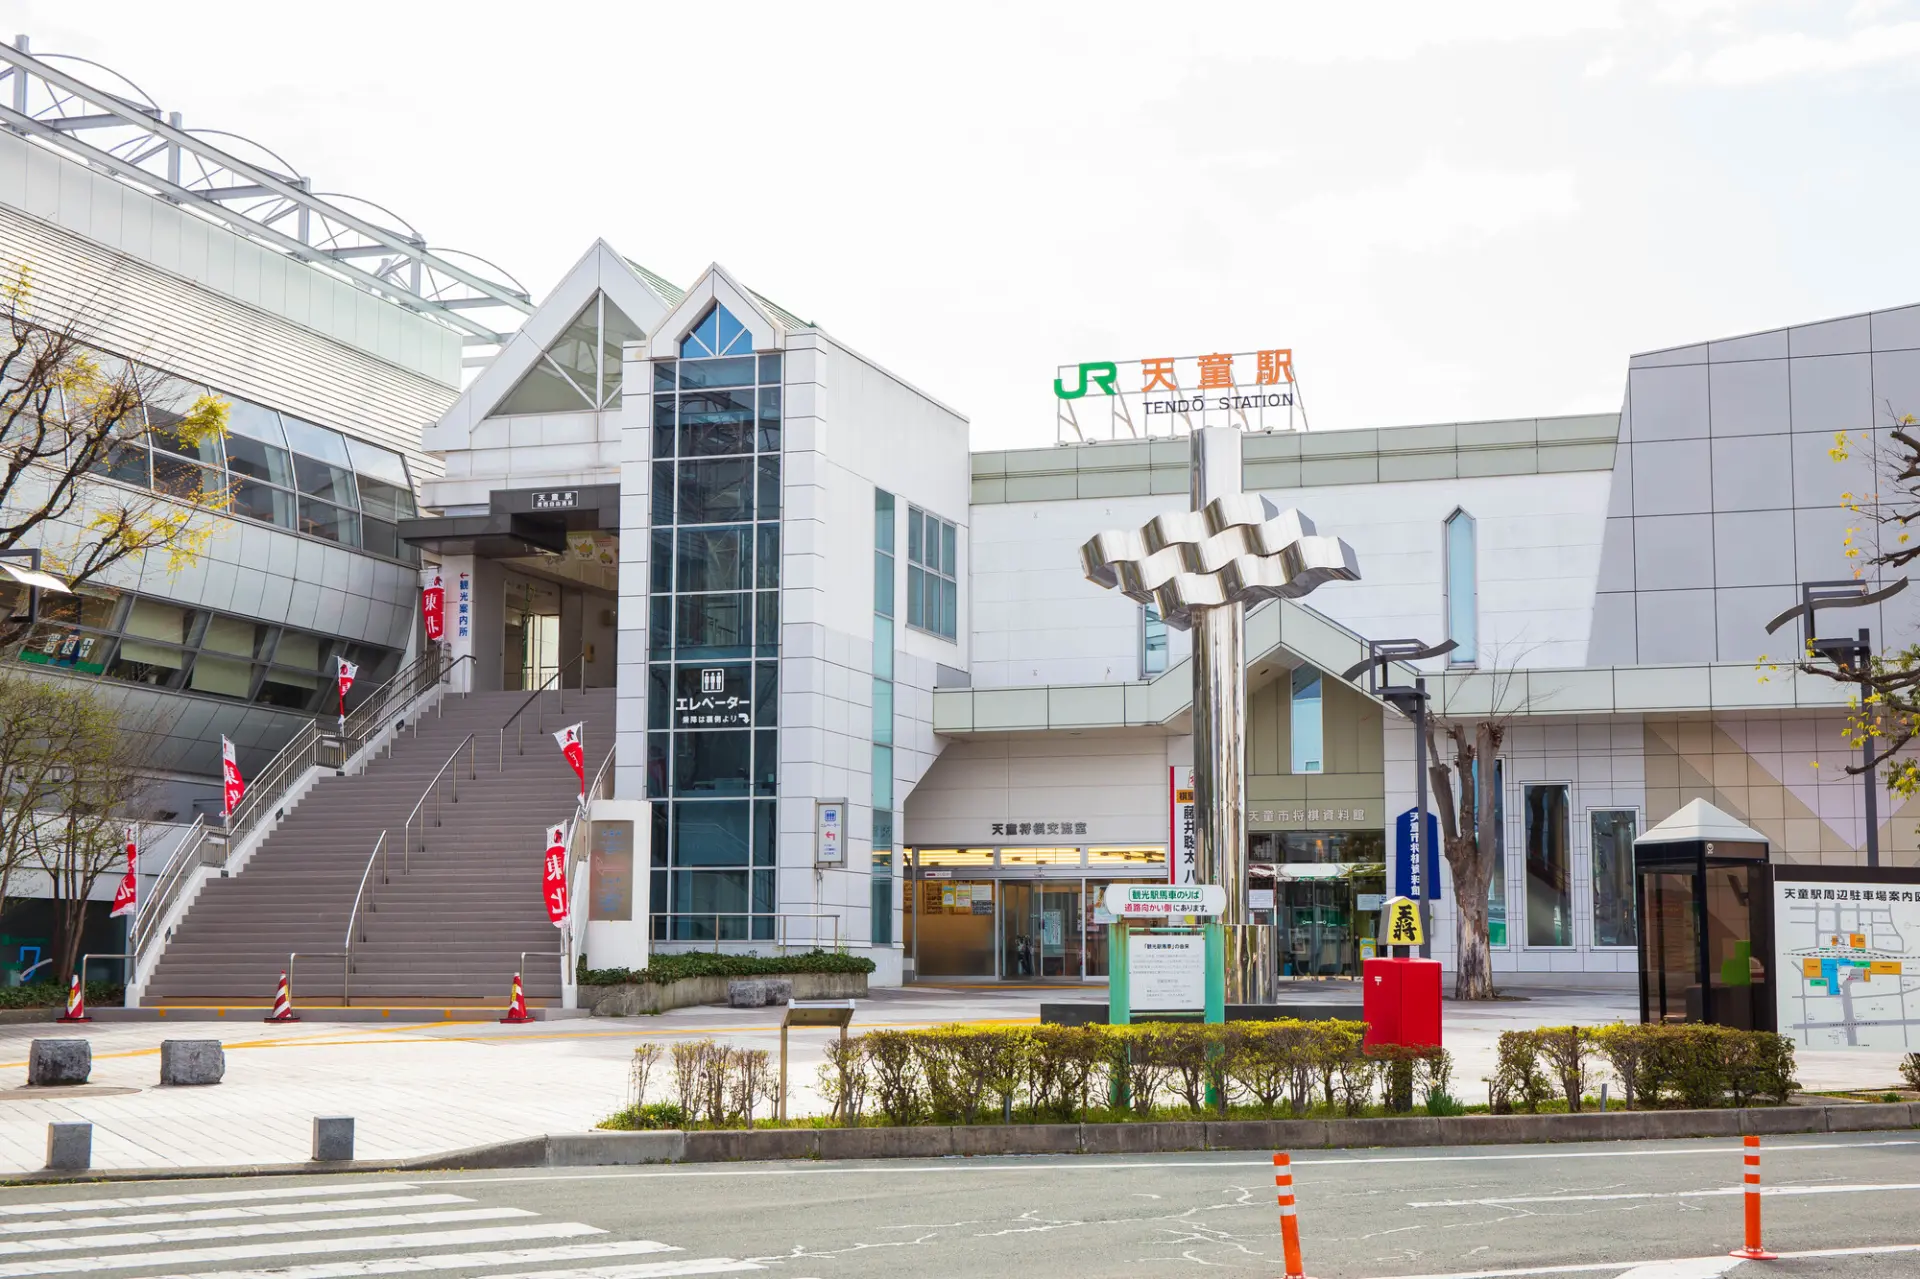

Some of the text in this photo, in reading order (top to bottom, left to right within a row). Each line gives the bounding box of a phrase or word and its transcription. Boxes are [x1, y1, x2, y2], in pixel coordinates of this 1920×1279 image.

[1053, 349, 1294, 400] JR 天童駅
[1219, 393, 1293, 410] STATION
[458, 580, 469, 637] 観光案内所
[675, 696, 750, 711] エレベーター
[1248, 808, 1365, 822] 天童市将棋資料館
[991, 822, 1087, 836] 天童将棋交流室
